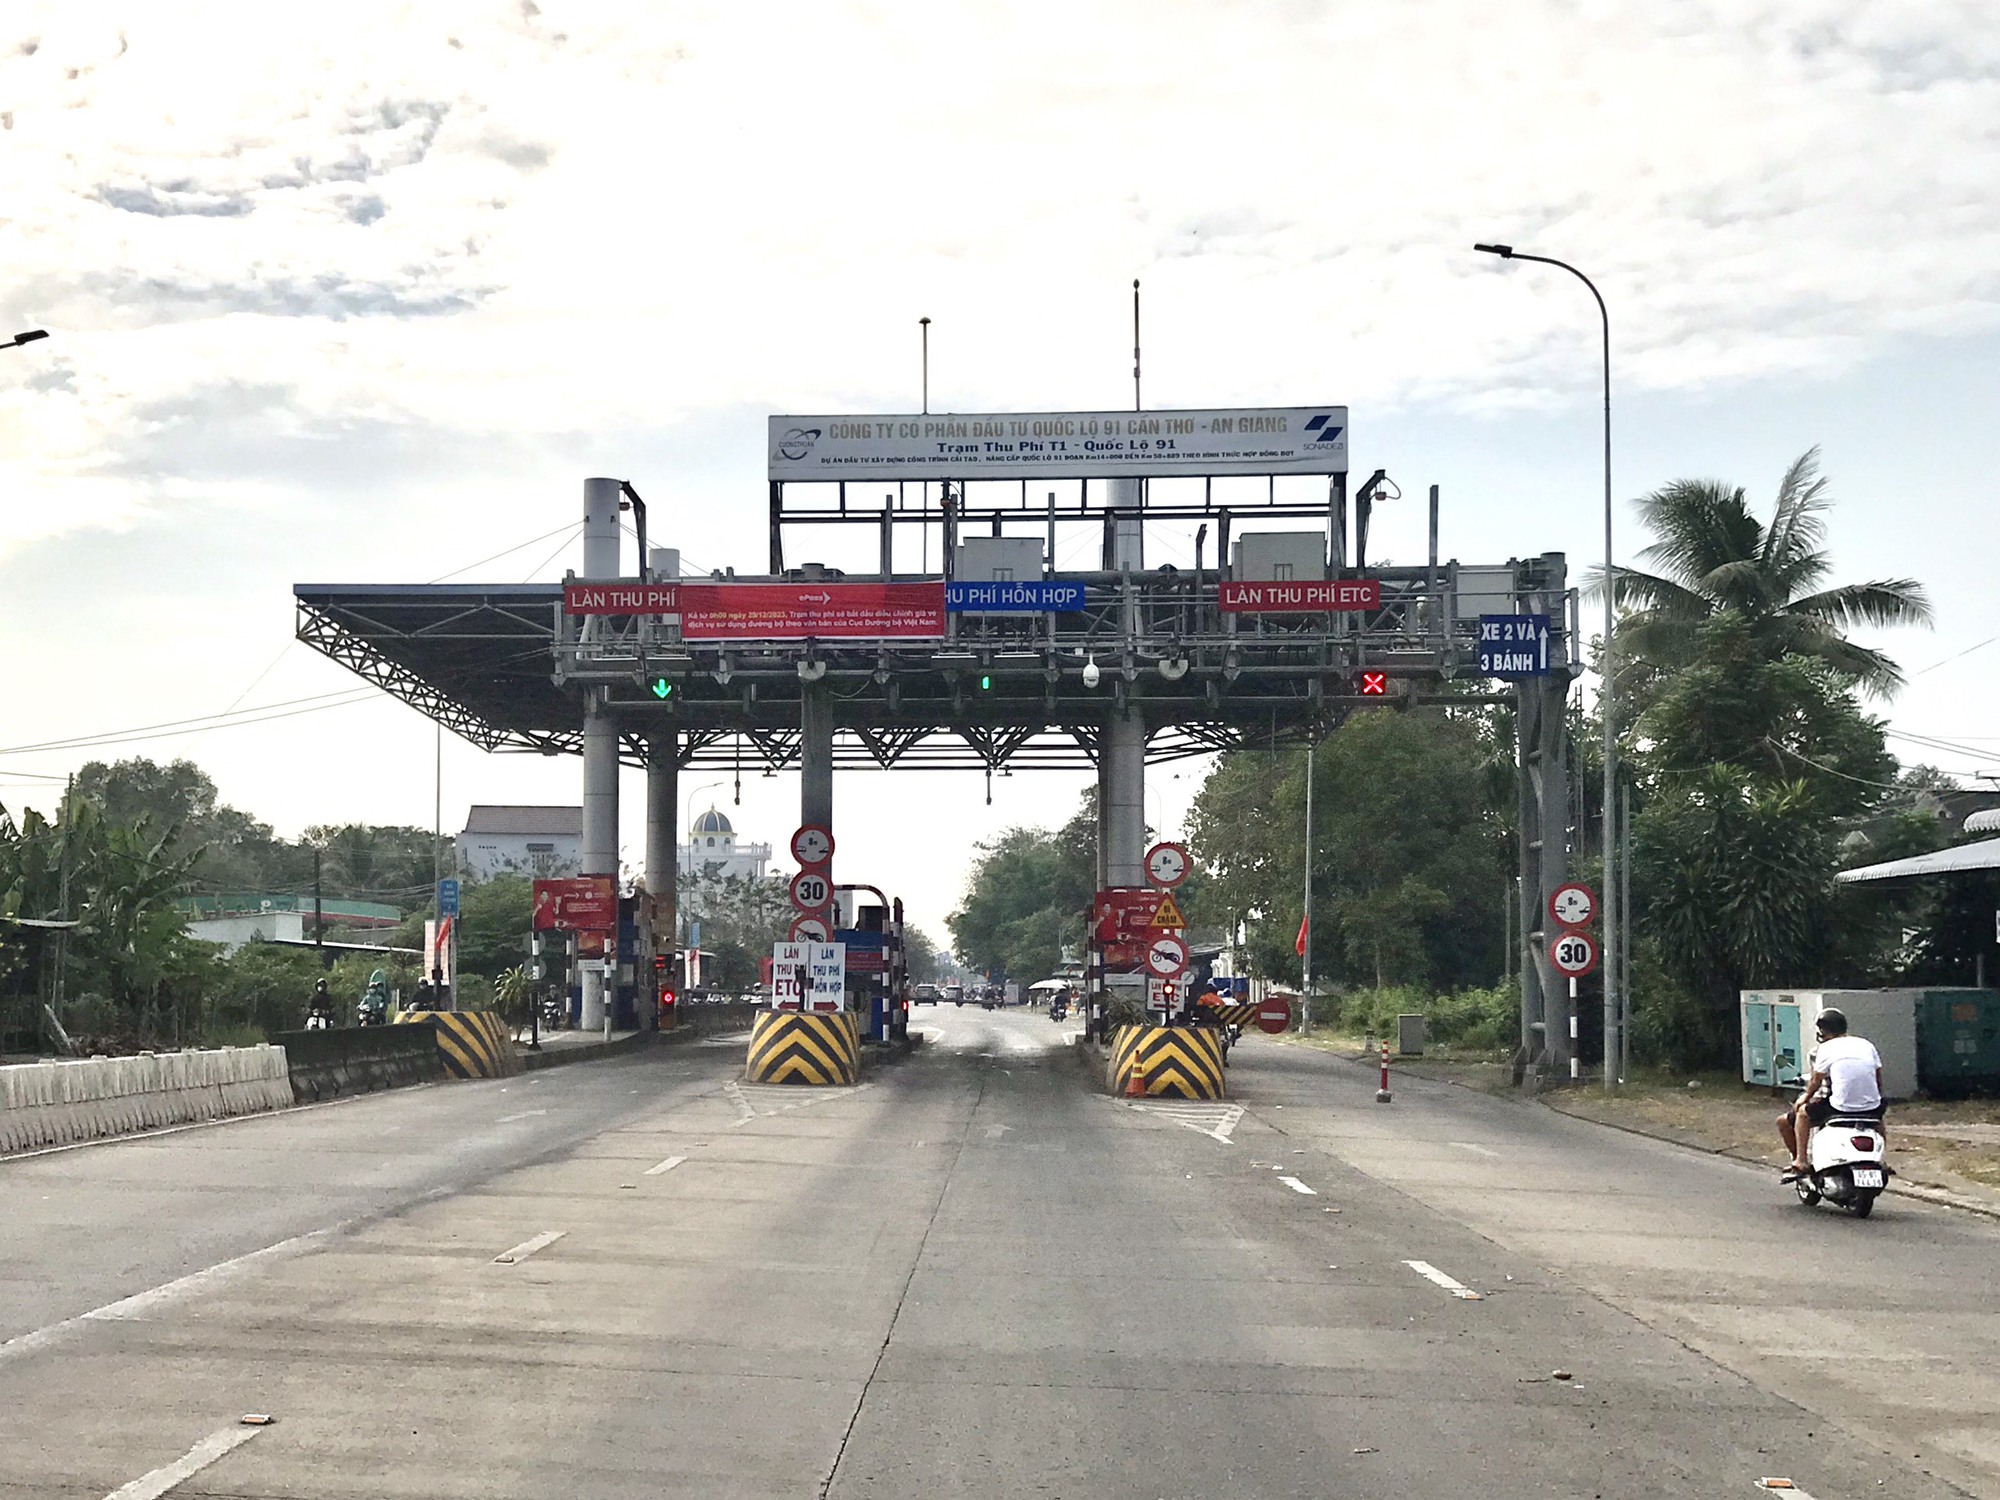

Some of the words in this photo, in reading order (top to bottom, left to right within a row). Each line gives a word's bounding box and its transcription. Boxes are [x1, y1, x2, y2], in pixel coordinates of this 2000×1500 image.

[829, 419, 872, 440] CÔNG
[875, 423, 894, 439] TY
[1009, 419, 1029, 437] TƯ
[1032, 415, 1075, 438] QUỐC
[1079, 416, 1099, 439] LỘ
[1103, 420, 1121, 435] 91
[1165, 416, 1196, 435] THƠ
[1211, 417, 1233, 434] AN
[1238, 416, 1288, 433] GIANG
[937, 442, 979, 455] Trạm
[984, 441, 1014, 452] Thu
[1019, 440, 1045, 452] Phí
[1049, 441, 1067, 451] T1
[1084, 439, 1124, 452] Quốc
[1129, 440, 1150, 453] Lộ
[1156, 439, 1176, 449] 91
[1302, 443, 1344, 451] SONADEZI
[571, 589, 606, 608] LÀN
[610, 591, 643, 607] THU
[648, 588, 676, 607] PHÍ
[969, 585, 997, 604] PHÍ
[1002, 582, 1037, 604] HỖN
[1042, 587, 1078, 607] HỢP
[1226, 585, 1262, 604] LÀN
[1267, 588, 1301, 604] THU
[1307, 583, 1336, 603] PHÍ
[1340, 587, 1372, 603] ETC
[848, 619, 863, 628] Cục
[903, 618, 917, 627] Việt
[1481, 623, 1500, 640] XE
[1504, 623, 1513, 640] 2
[1516, 618, 1536, 640] VÀ
[1480, 653, 1489, 671] 3
[1493, 648, 1533, 671] BÁNH
[800, 882, 824, 900] 30
[784, 945, 799, 959] LÀN
[821, 946, 834, 959] LÀN
[1560, 943, 1587, 963] 30
[777, 964, 792, 975] THU
[813, 965, 826, 976] THU
[829, 963, 840, 976] PHÍ
[829, 981, 842, 996] HỢP
